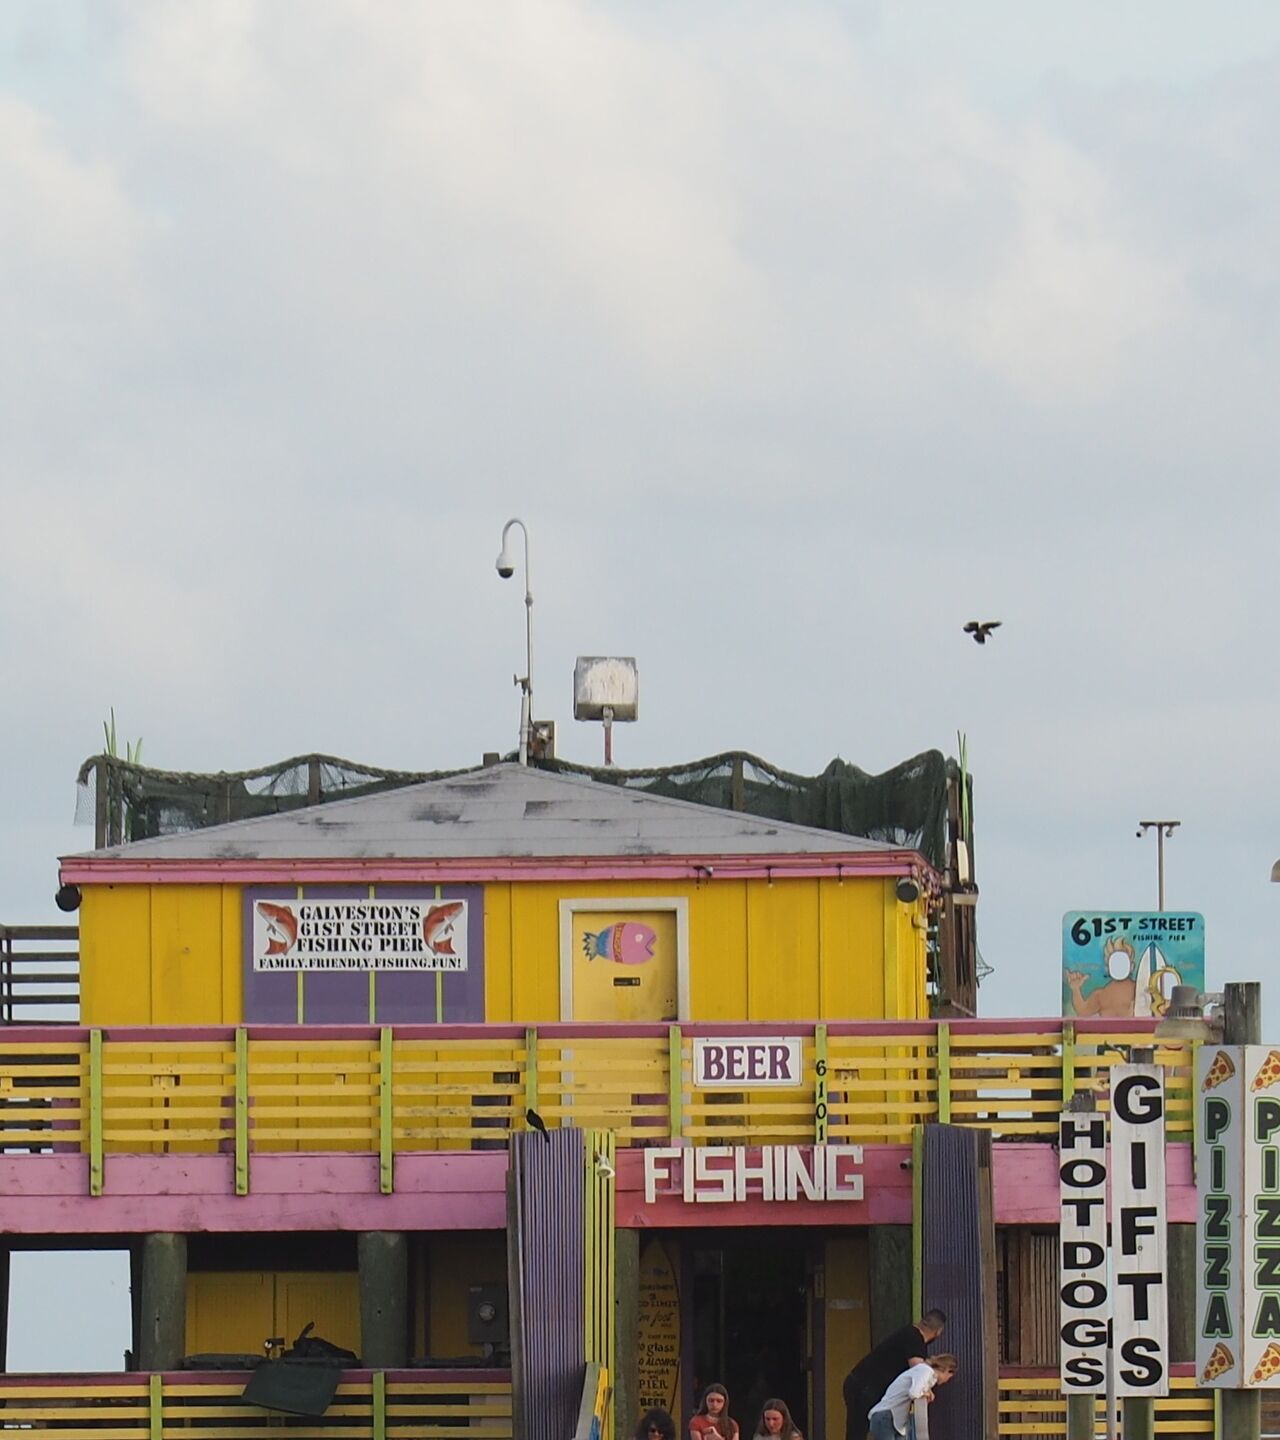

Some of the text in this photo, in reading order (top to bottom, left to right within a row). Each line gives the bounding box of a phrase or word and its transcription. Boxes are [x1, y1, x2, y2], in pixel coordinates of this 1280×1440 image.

[299, 906, 420, 920] GALVESTON'S
[301, 922, 420, 936] 61ST STREET
[297, 938, 424, 952] FISHING PIER
[1071, 917, 1195, 946] 61ST STREET
[702, 1045, 791, 1080] BEER
[815, 1060, 827, 1141] 6101
[644, 1145, 864, 1203] FISHING
[1113, 1075, 1163, 1387] GIFTS
[1204, 1097, 1232, 1339] PIZZA
